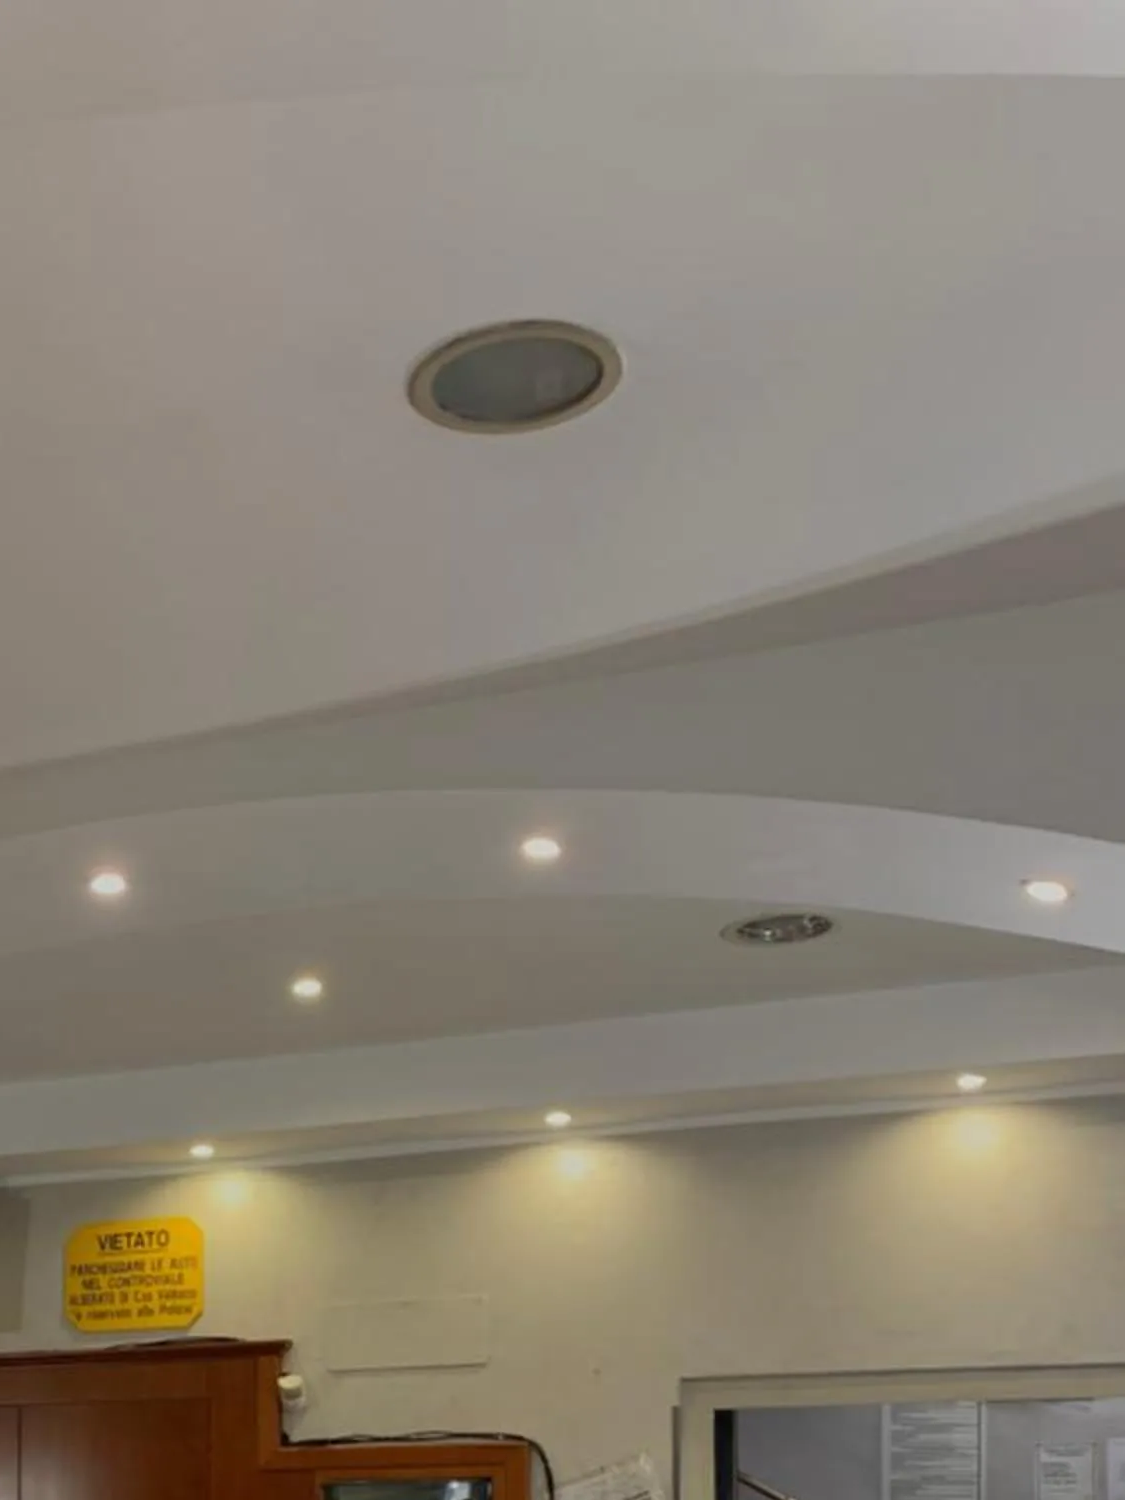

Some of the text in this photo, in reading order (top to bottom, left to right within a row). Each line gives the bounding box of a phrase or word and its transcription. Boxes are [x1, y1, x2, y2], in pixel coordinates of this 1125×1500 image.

[97, 1230, 170, 1251] VIETATO
[81, 1272, 185, 1291] NEL CONTROVIALE
